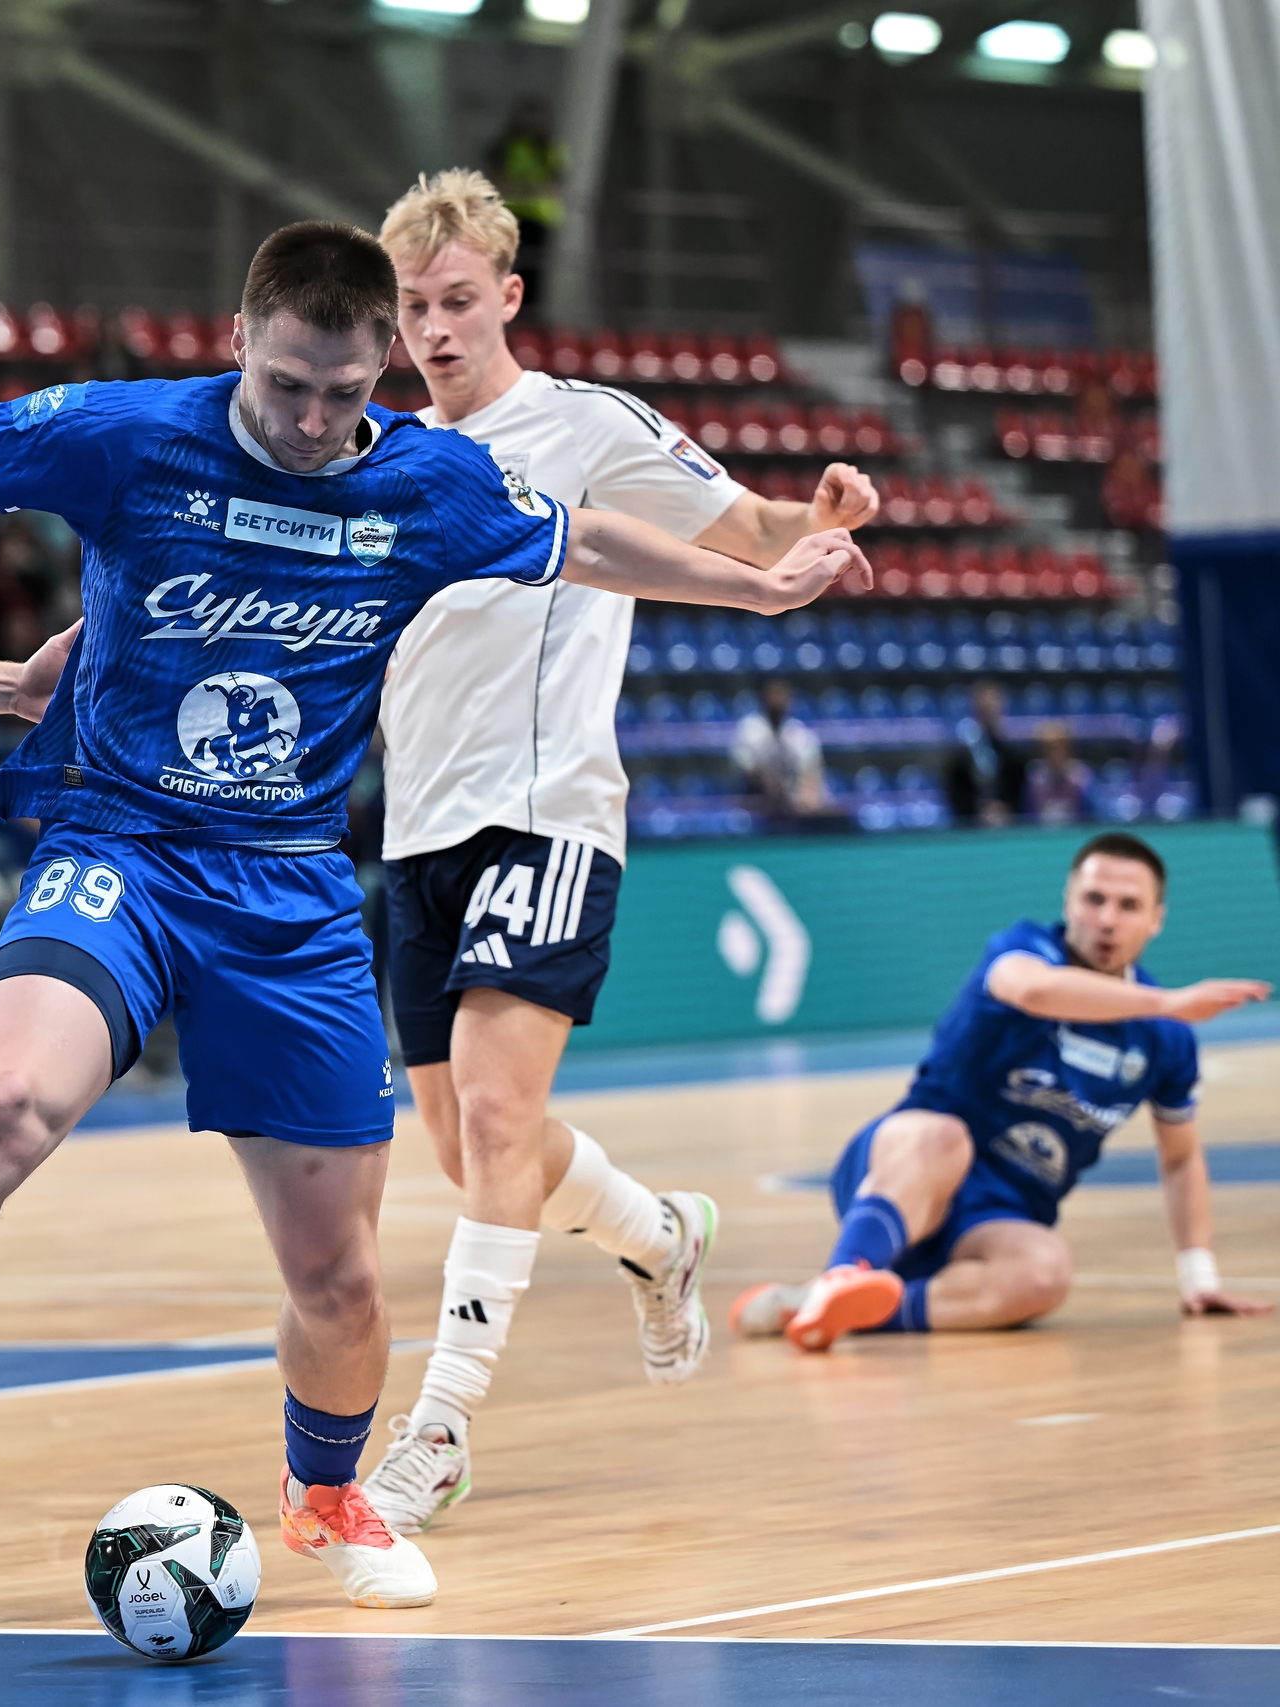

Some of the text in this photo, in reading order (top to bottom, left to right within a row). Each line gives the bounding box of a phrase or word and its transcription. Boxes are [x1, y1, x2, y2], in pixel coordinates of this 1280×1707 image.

[173, 511, 220, 531] KELME
[233, 512, 335, 541] БЕТСИТИ
[141, 573, 388, 652] Сургут
[158, 774, 306, 801] СИБПРОМСТРОЙ
[25, 856, 125, 923] 89
